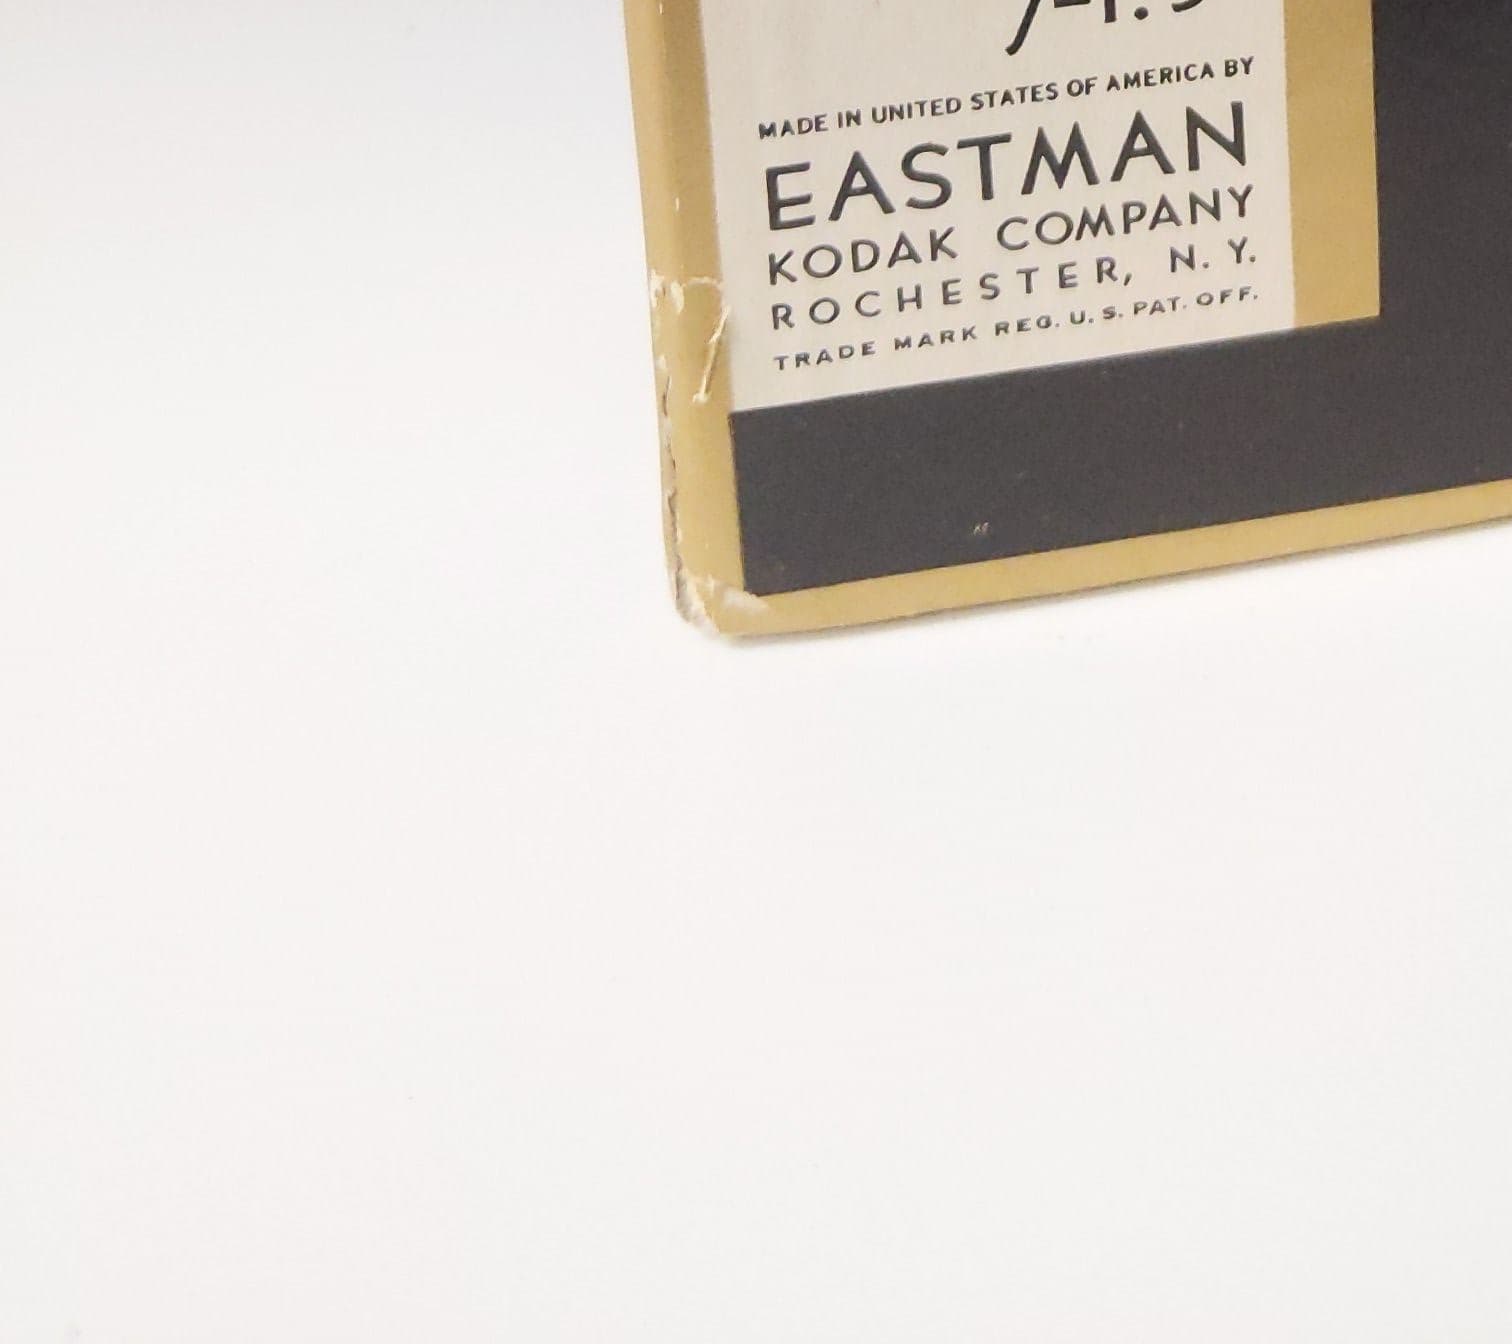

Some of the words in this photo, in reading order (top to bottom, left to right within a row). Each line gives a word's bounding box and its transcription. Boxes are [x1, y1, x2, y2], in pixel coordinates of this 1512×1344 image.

[758, 113, 829, 140] MADE
[837, 108, 862, 129] IN
[871, 96, 962, 125] UNITED
[970, 82, 1059, 111] STATES
[1066, 75, 1098, 98] OF
[1106, 62, 1215, 92] AMERICA
[1224, 55, 1254, 79] BY
[765, 100, 1247, 231] EASTMAN
[768, 225, 958, 286] KODAK
[996, 183, 1254, 251] COMPANY
[771, 255, 1132, 330] ROCHESTER,
[773, 339, 877, 371] TRADE
[894, 325, 978, 351] MARK
[994, 314, 1060, 337] REG.
[1133, 296, 1188, 316] PAT.
[1196, 285, 1259, 307] OFF.
